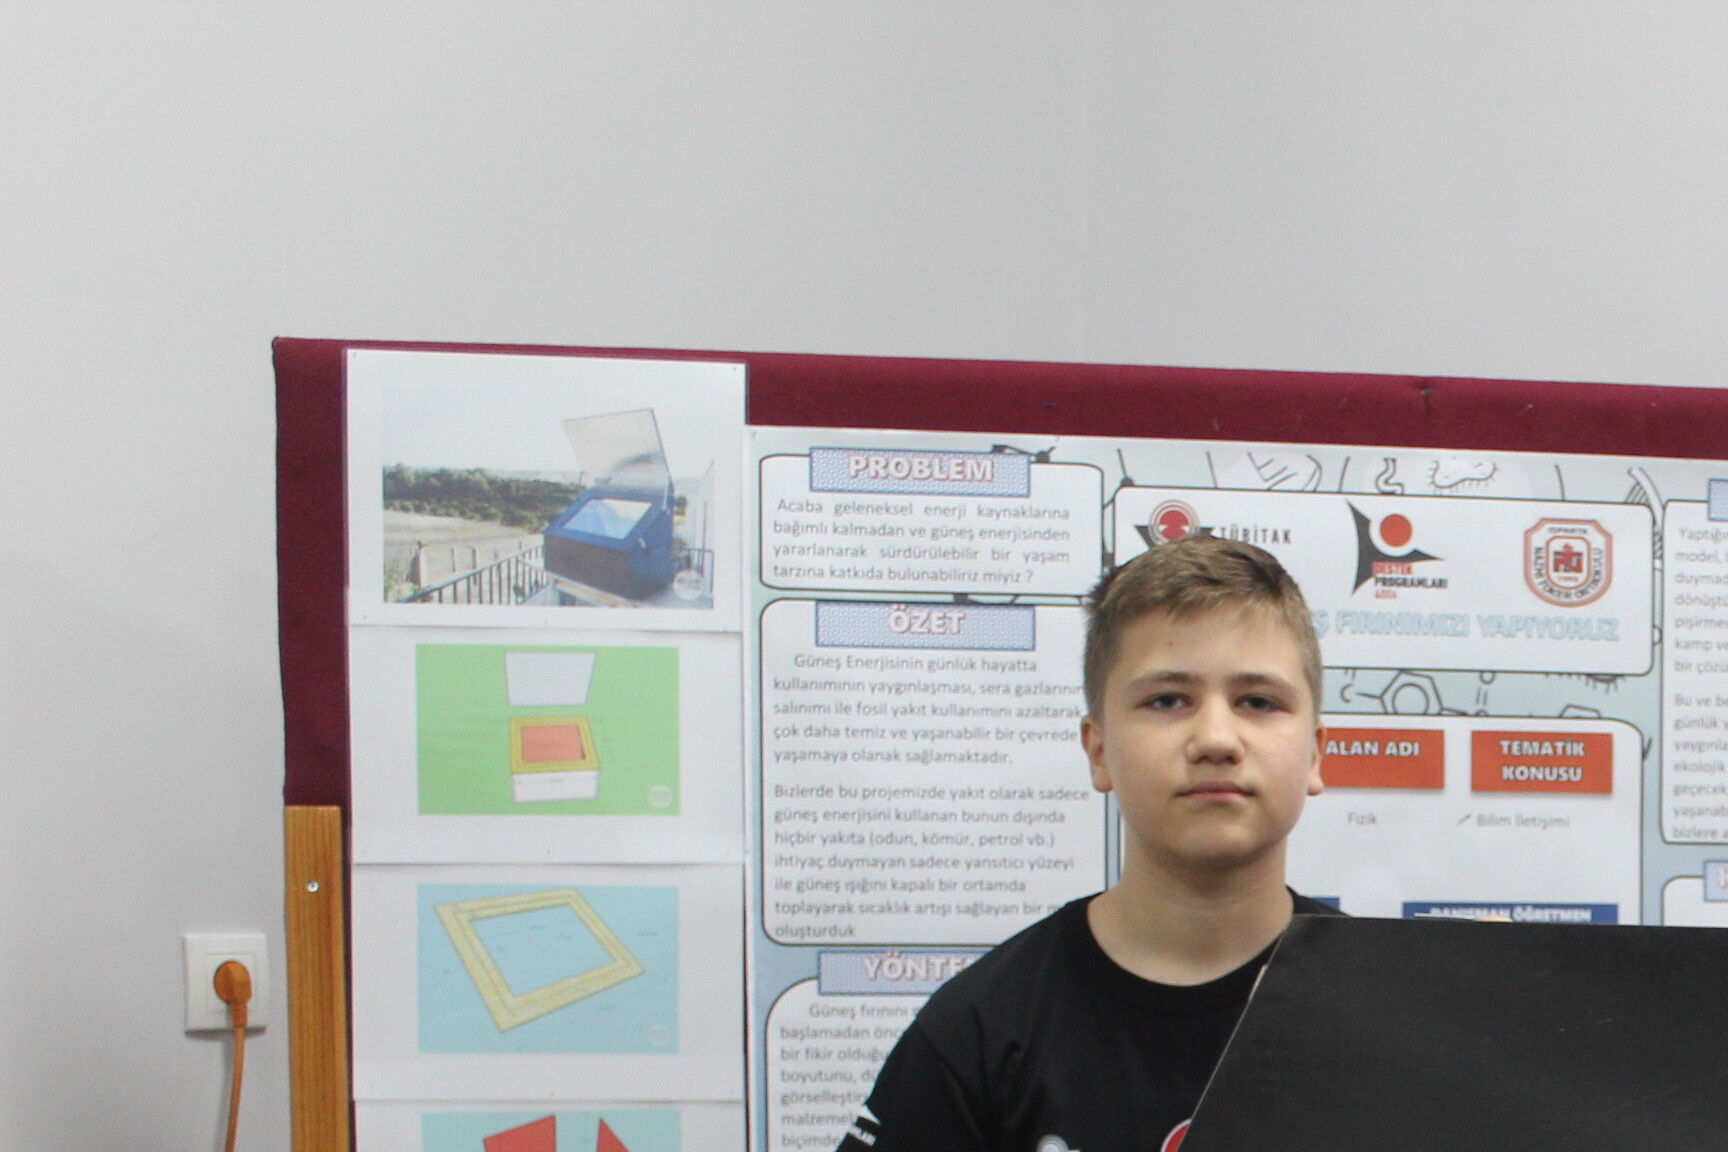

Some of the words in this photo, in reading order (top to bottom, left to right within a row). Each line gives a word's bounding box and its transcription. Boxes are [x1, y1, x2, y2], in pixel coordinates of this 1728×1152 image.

[850, 456, 994, 482] PROBLEM
[888, 604, 966, 634] ÖZET
[1477, 613, 1622, 641] YAPIYORUZ
[1326, 740, 1379, 756] ALAN
[1385, 741, 1420, 757] ADI
[1499, 737, 1585, 757] TEMATİK
[1502, 766, 1583, 782] KONUSU
[1348, 811, 1378, 826] Fizik
[1477, 812, 1512, 827] Bilim
